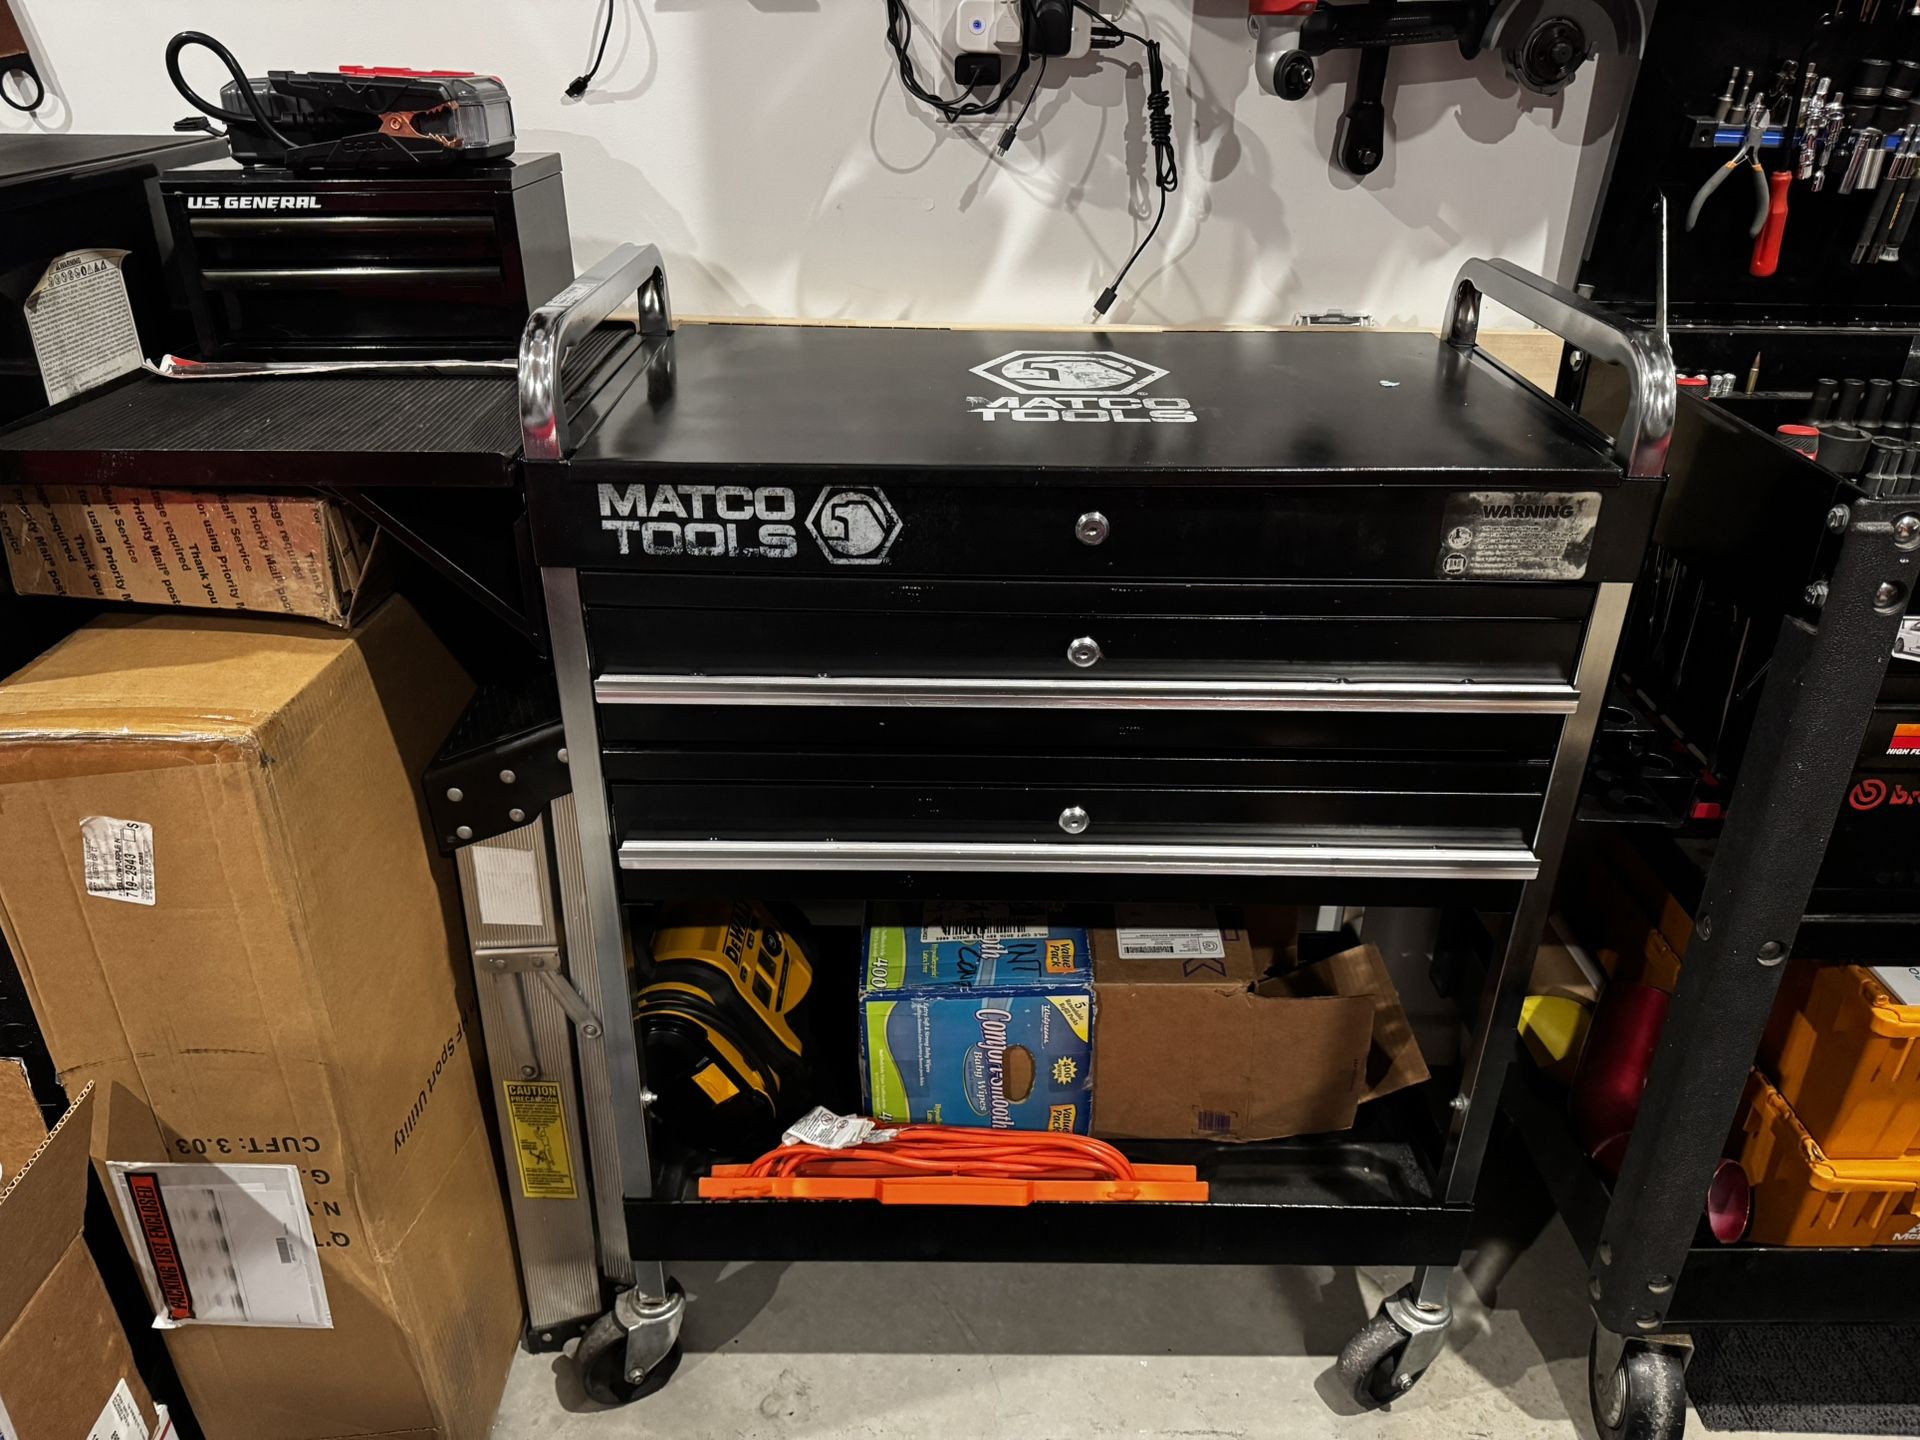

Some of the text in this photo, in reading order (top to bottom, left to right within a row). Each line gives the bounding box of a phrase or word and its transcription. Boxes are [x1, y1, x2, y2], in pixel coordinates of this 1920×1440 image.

[187, 196, 321, 209] U.S. GENERAL
[966, 396, 1191, 409] MATCO
[967, 409, 1198, 423] TOOLS
[13, 489, 39, 534] Priority
[130, 497, 154, 543] Priority
[597, 483, 796, 520] MATCO
[1482, 505, 1574, 519] WARNING
[48, 512, 77, 562] required
[78, 489, 91, 508] for
[87, 510, 107, 543] using
[102, 546, 127, 590] Priority
[115, 519, 138, 564] Service
[164, 520, 192, 572] required
[247, 506, 269, 551] Priority
[601, 520, 798, 558] TOOLS
[74, 534, 105, 596] Thank you
[203, 520, 221, 553] using
[217, 555, 240, 599] Priority
[230, 528, 252, 573] Service
[279, 530, 306, 581] required
[304, 552, 324, 588] Thank
[189, 543, 218, 604] Thank you
[869, 957, 889, 989] 400
[1049, 944, 1060, 967] Pack
[1060, 943, 1071, 968] Value
[1041, 1004, 1051, 1044] Walgreens
[1067, 1011, 1079, 1026] Packs
[1074, 1001, 1086, 1009] 5
[427, 1038, 455, 1093] Sport
[973, 1051, 987, 1111] Baby Wipes
[1062, 1061, 1072, 1079] 400
[509, 1085, 557, 1096] CAUTION
[394, 1090, 428, 1154] Utility
[1051, 1109, 1062, 1132] Pack
[1062, 1107, 1073, 1134] Value
[175, 1136, 321, 1154] CUFT: 3.03
[136, 1186, 189, 1309] PACKING LIST ENCLOSED
